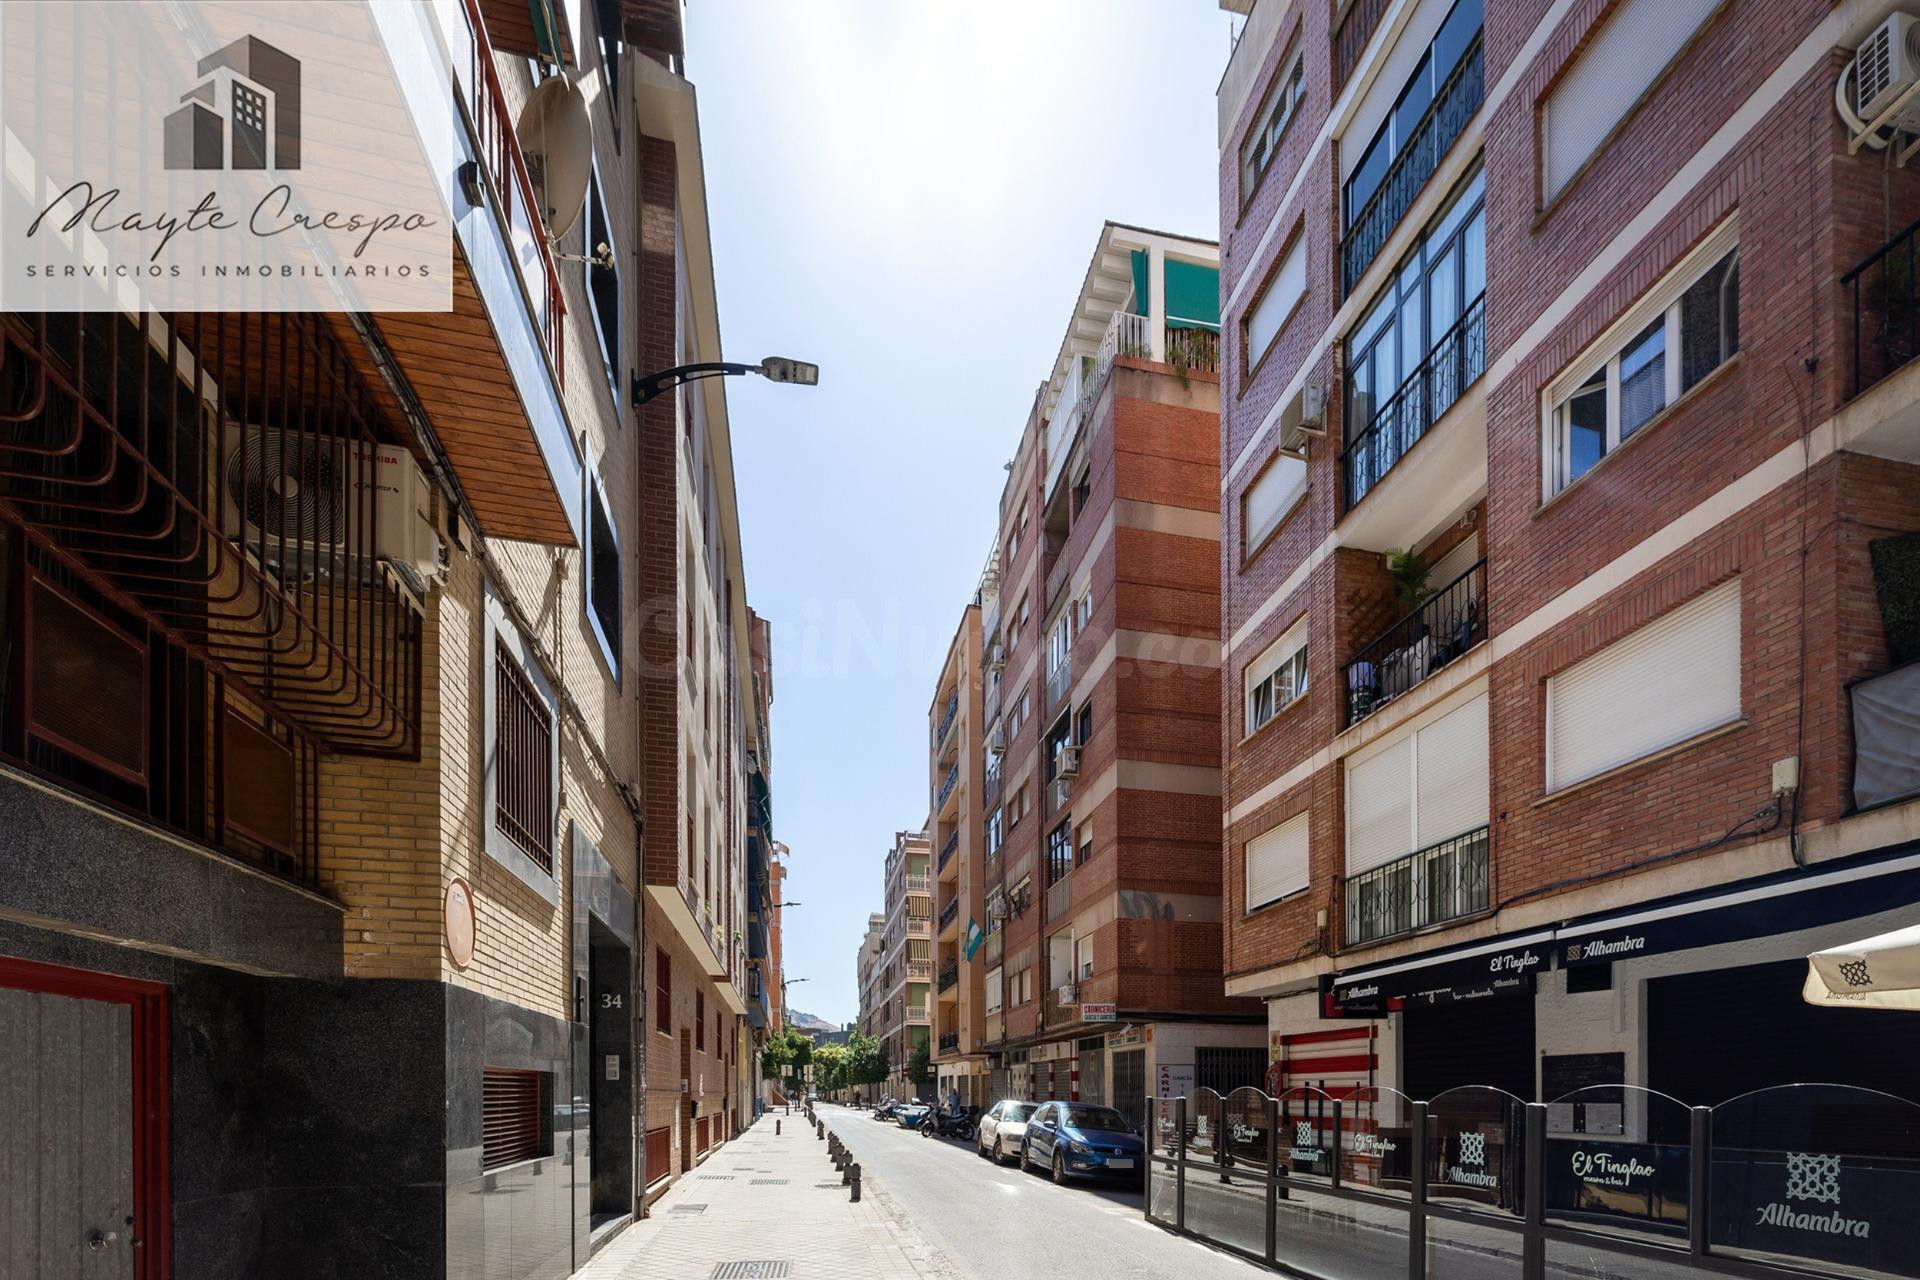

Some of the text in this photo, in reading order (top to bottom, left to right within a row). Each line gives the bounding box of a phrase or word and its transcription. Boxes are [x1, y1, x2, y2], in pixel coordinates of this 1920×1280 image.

[1583, 936, 1645, 959] Alhambra
[1490, 950, 1540, 973] El Tinglao
[601, 993, 623, 1009] 34
[1347, 984, 1379, 1000] Alhambra
[1160, 1065, 1171, 1122] CARNICER
[1289, 1148, 1319, 1161] Alhambra
[1355, 1134, 1397, 1158] El Tinglao
[1447, 1165, 1497, 1187] Alhambra
[1571, 1151, 1656, 1186] El Tinglao
[1755, 1202, 1870, 1239] Alhambra
